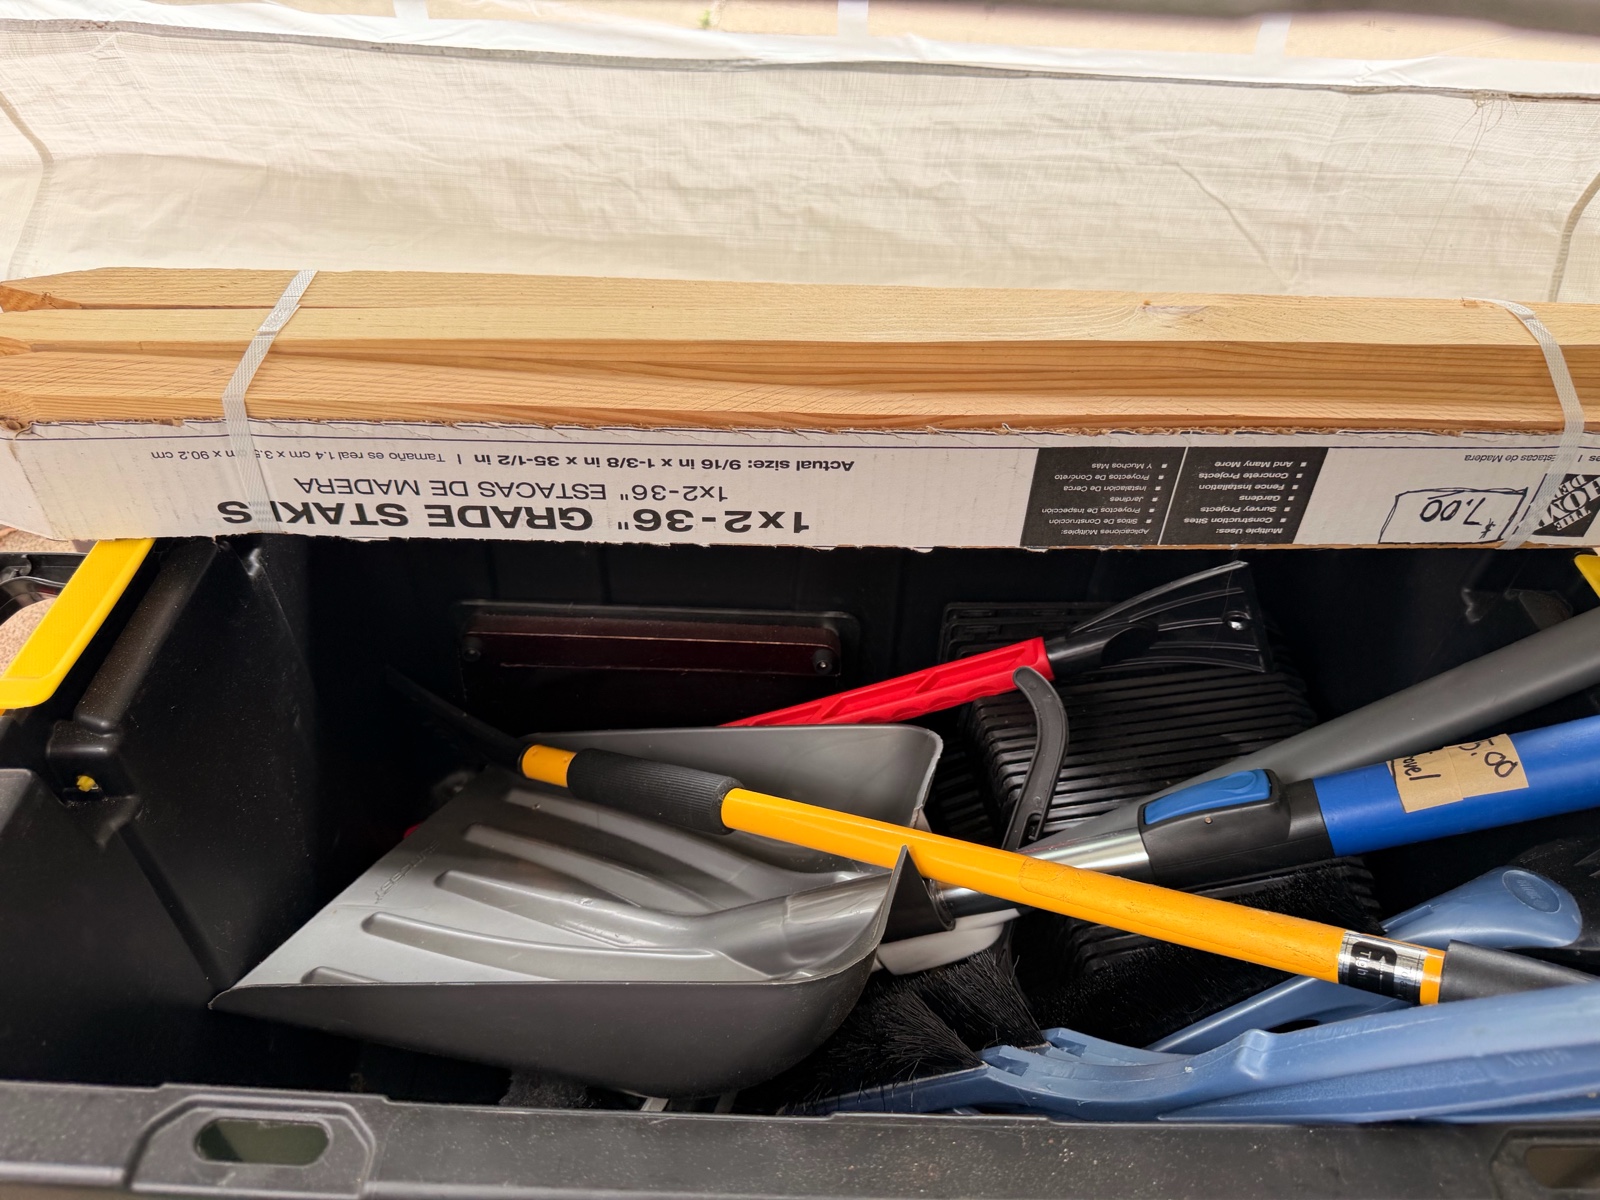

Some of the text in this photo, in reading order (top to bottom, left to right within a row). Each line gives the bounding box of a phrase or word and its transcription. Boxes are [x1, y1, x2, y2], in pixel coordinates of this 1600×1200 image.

[151, 451, 173, 460] cm
[178, 450, 209, 460] 90.2
[212, 450, 222, 458] x
[276, 450, 285, 458] x
[290, 450, 310, 459] cm
[316, 451, 335, 460] 1.4
[338, 451, 363, 461] real
[368, 451, 384, 460] es
[389, 451, 445, 463] Tamaño
[474, 454, 855, 471] Actual size: 9/16 in x 1-3/8 in x 35-1/2 in
[1464, 455, 1503, 463] Madera
[1505, 455, 1519, 463] de
[1243, 460, 1271, 468] Many
[1109, 473, 1150, 481] Proyectos
[1198, 472, 1240, 480] Projects
[293, 478, 728, 502] 1x2-36" ESTACAS DE MADERA
[1100, 506, 1141, 514] Proyectos
[424, 504, 593, 531] GRADE
[1553, 507, 1591, 531] THE
[1245, 526, 1283, 535] Multiple
